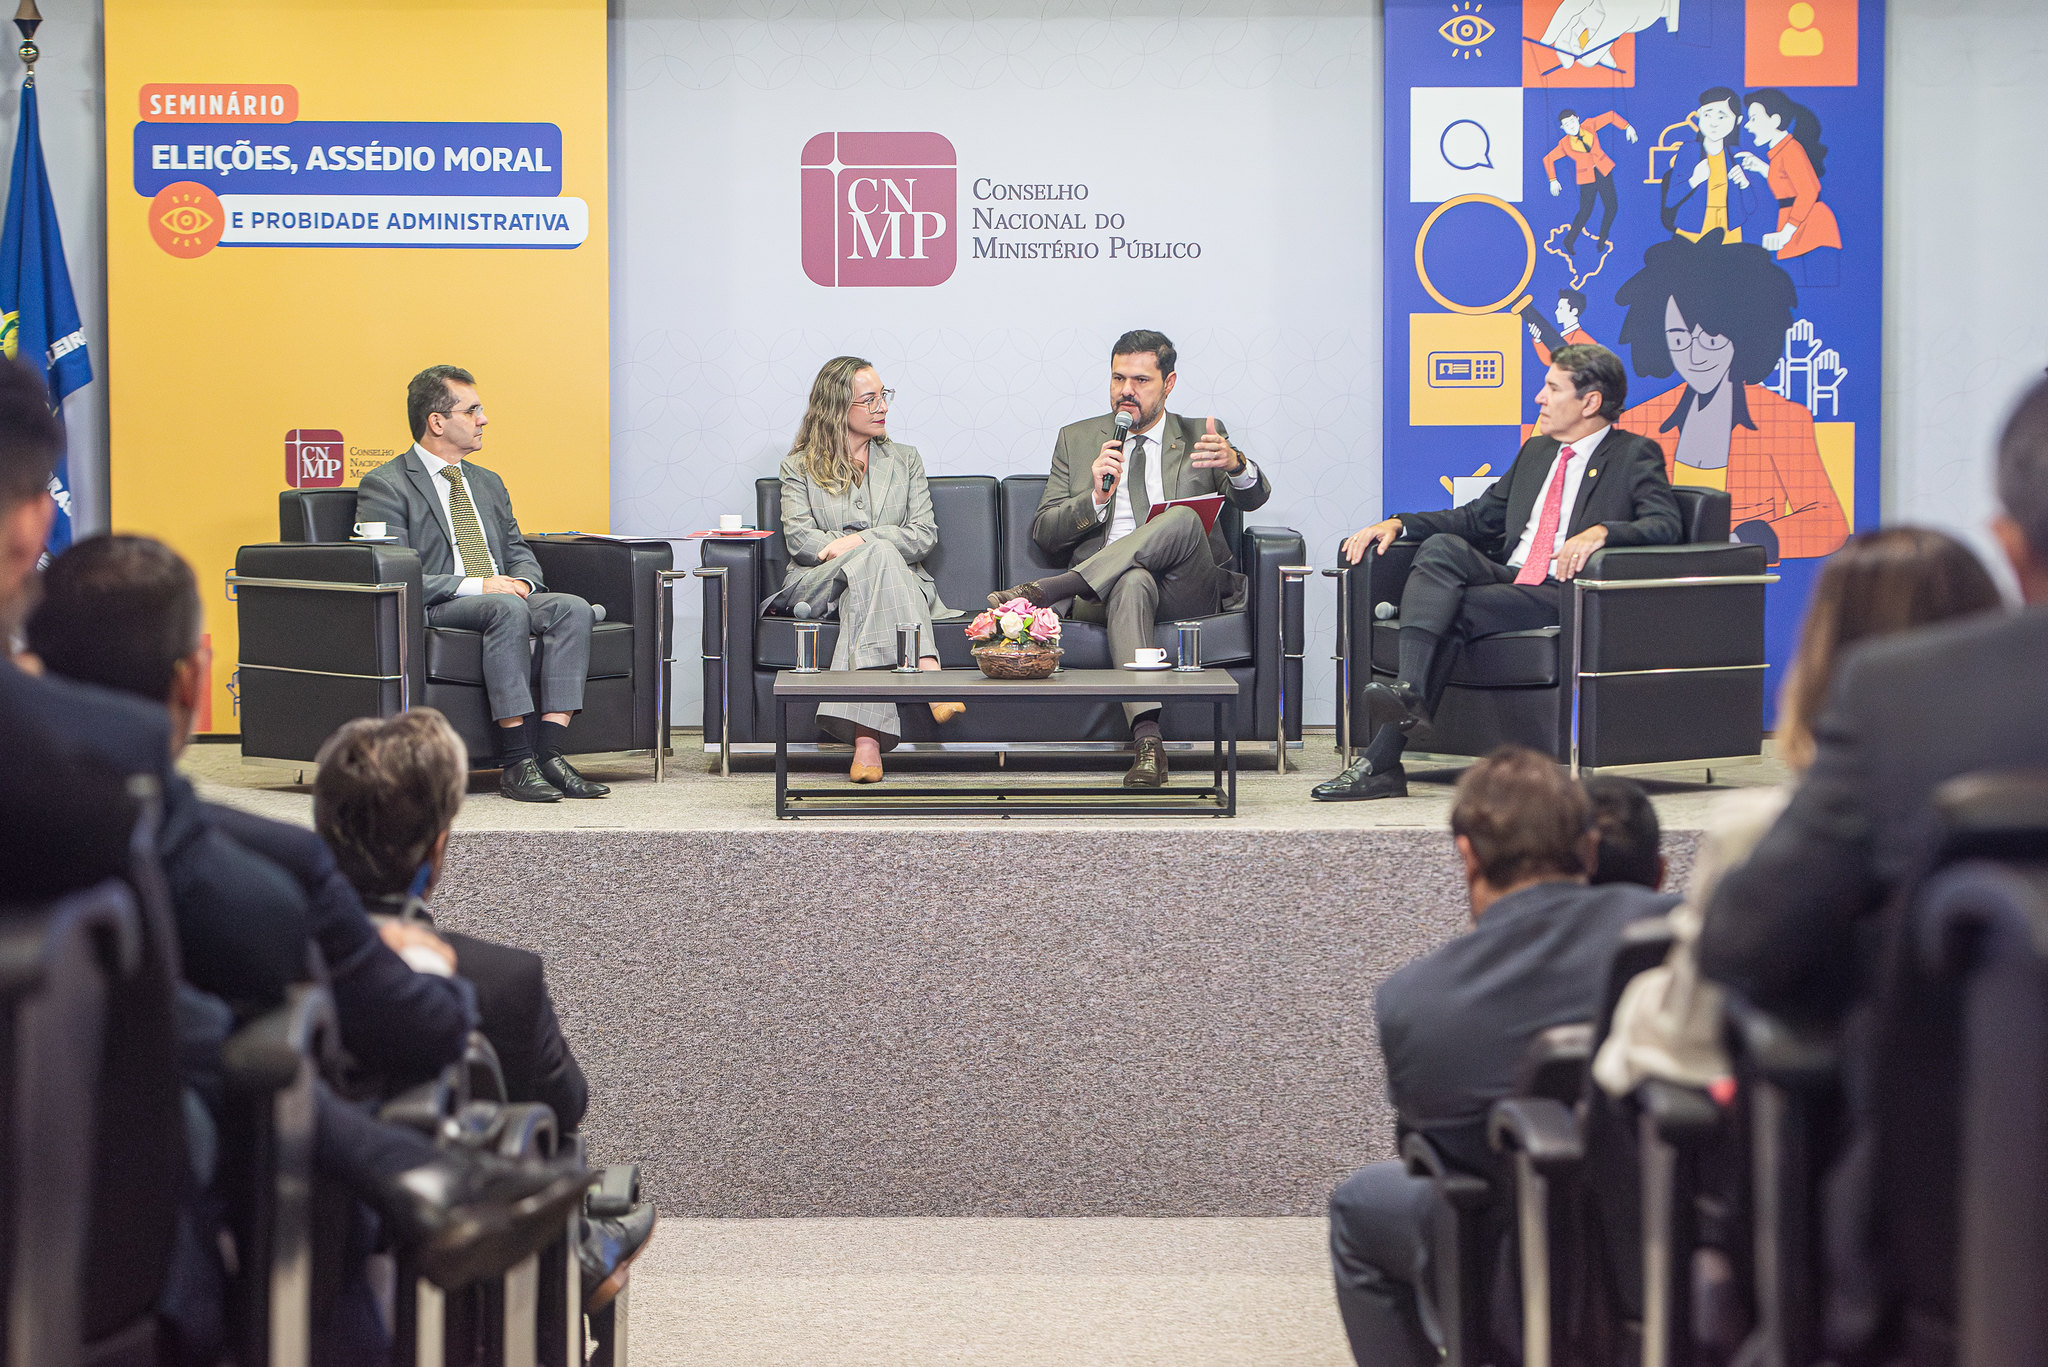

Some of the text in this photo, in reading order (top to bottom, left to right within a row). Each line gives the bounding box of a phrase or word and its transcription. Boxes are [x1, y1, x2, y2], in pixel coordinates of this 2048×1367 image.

[149, 91, 286, 117] SEMINÁRIO
[151, 139, 552, 177] ELEIÇÕES, ASSÉDIO MORAL
[971, 177, 1089, 202] CONSELHO
[232, 211, 570, 232] E PROBIDADE ADMINISTRATIVA
[971, 207, 1087, 231] NACIONAL
[971, 236, 1202, 260] MINISTÉRIO PÚBLICO
[349, 446, 395, 457] CONSELHO
